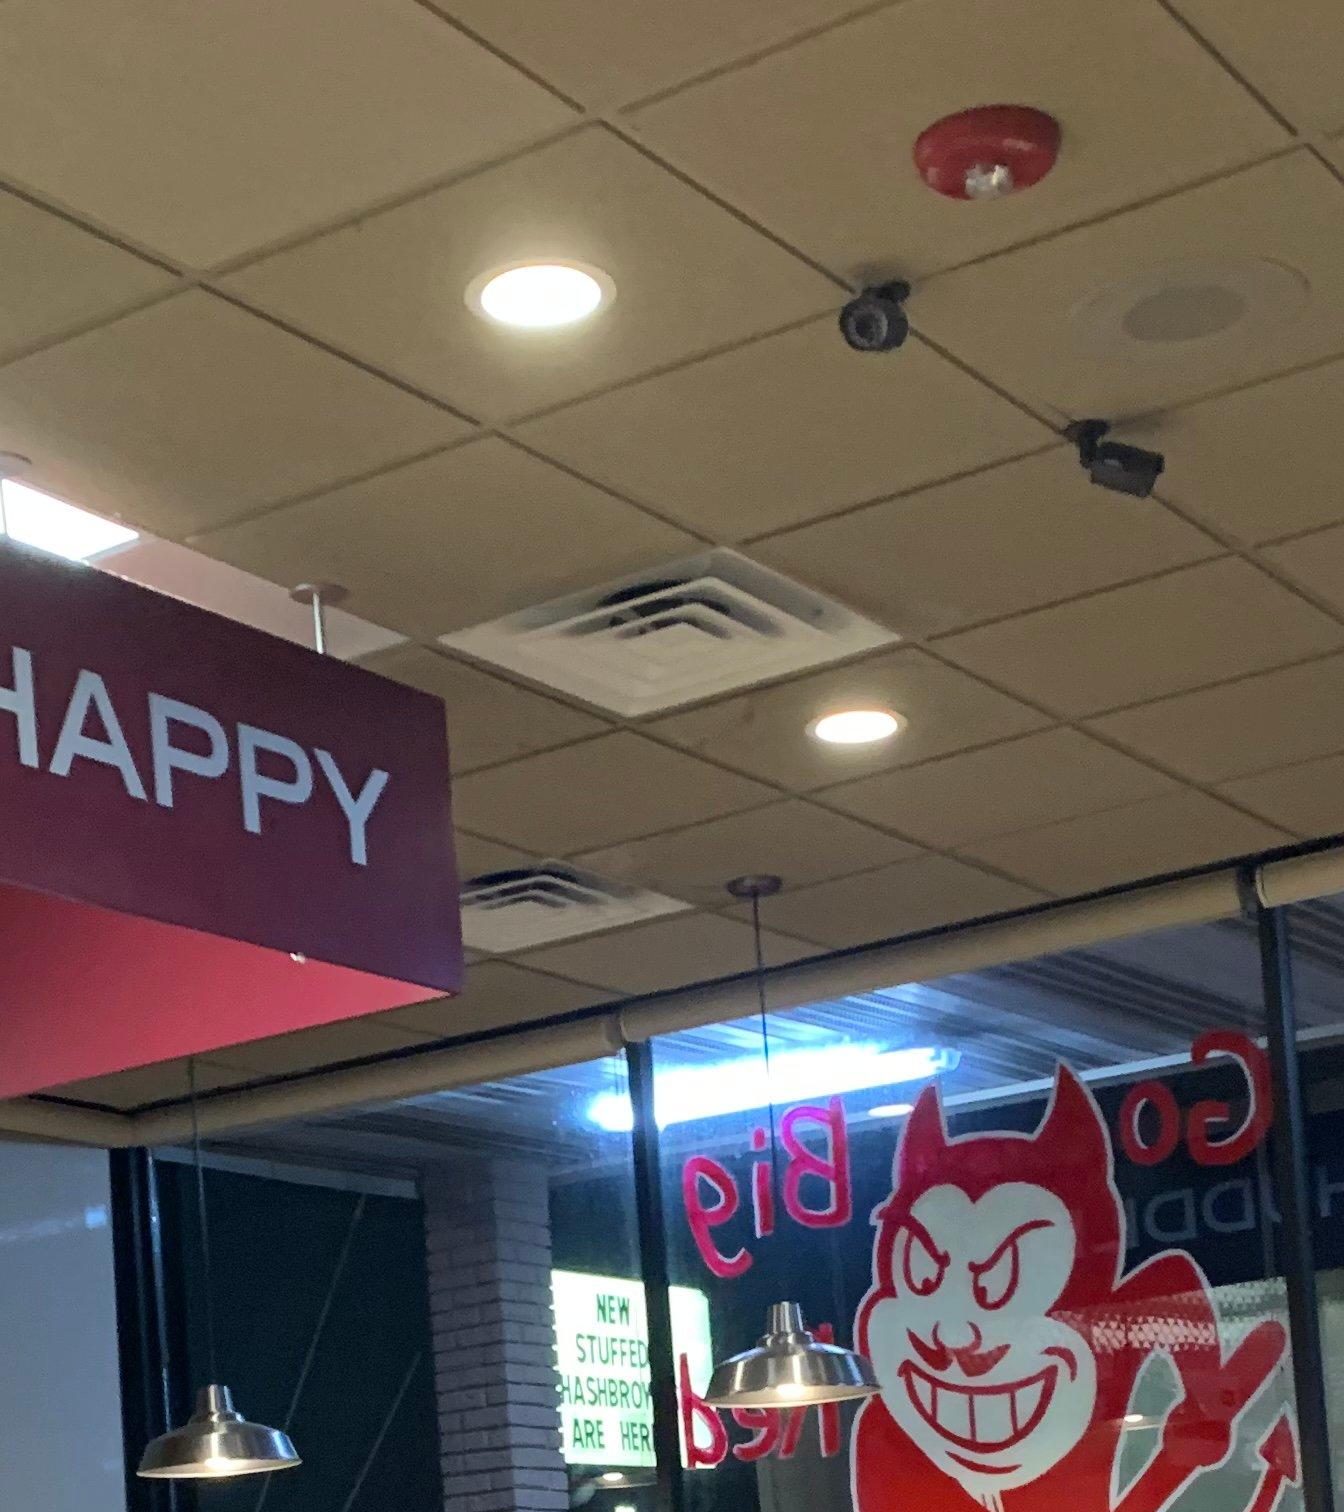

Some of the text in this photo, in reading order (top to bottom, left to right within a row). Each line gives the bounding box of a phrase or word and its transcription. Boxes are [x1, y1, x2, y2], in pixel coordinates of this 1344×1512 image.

[596, 1293, 630, 1326] NEW
[575, 1333, 649, 1368] STUFFED
[572, 1418, 653, 1452] ARE HER
